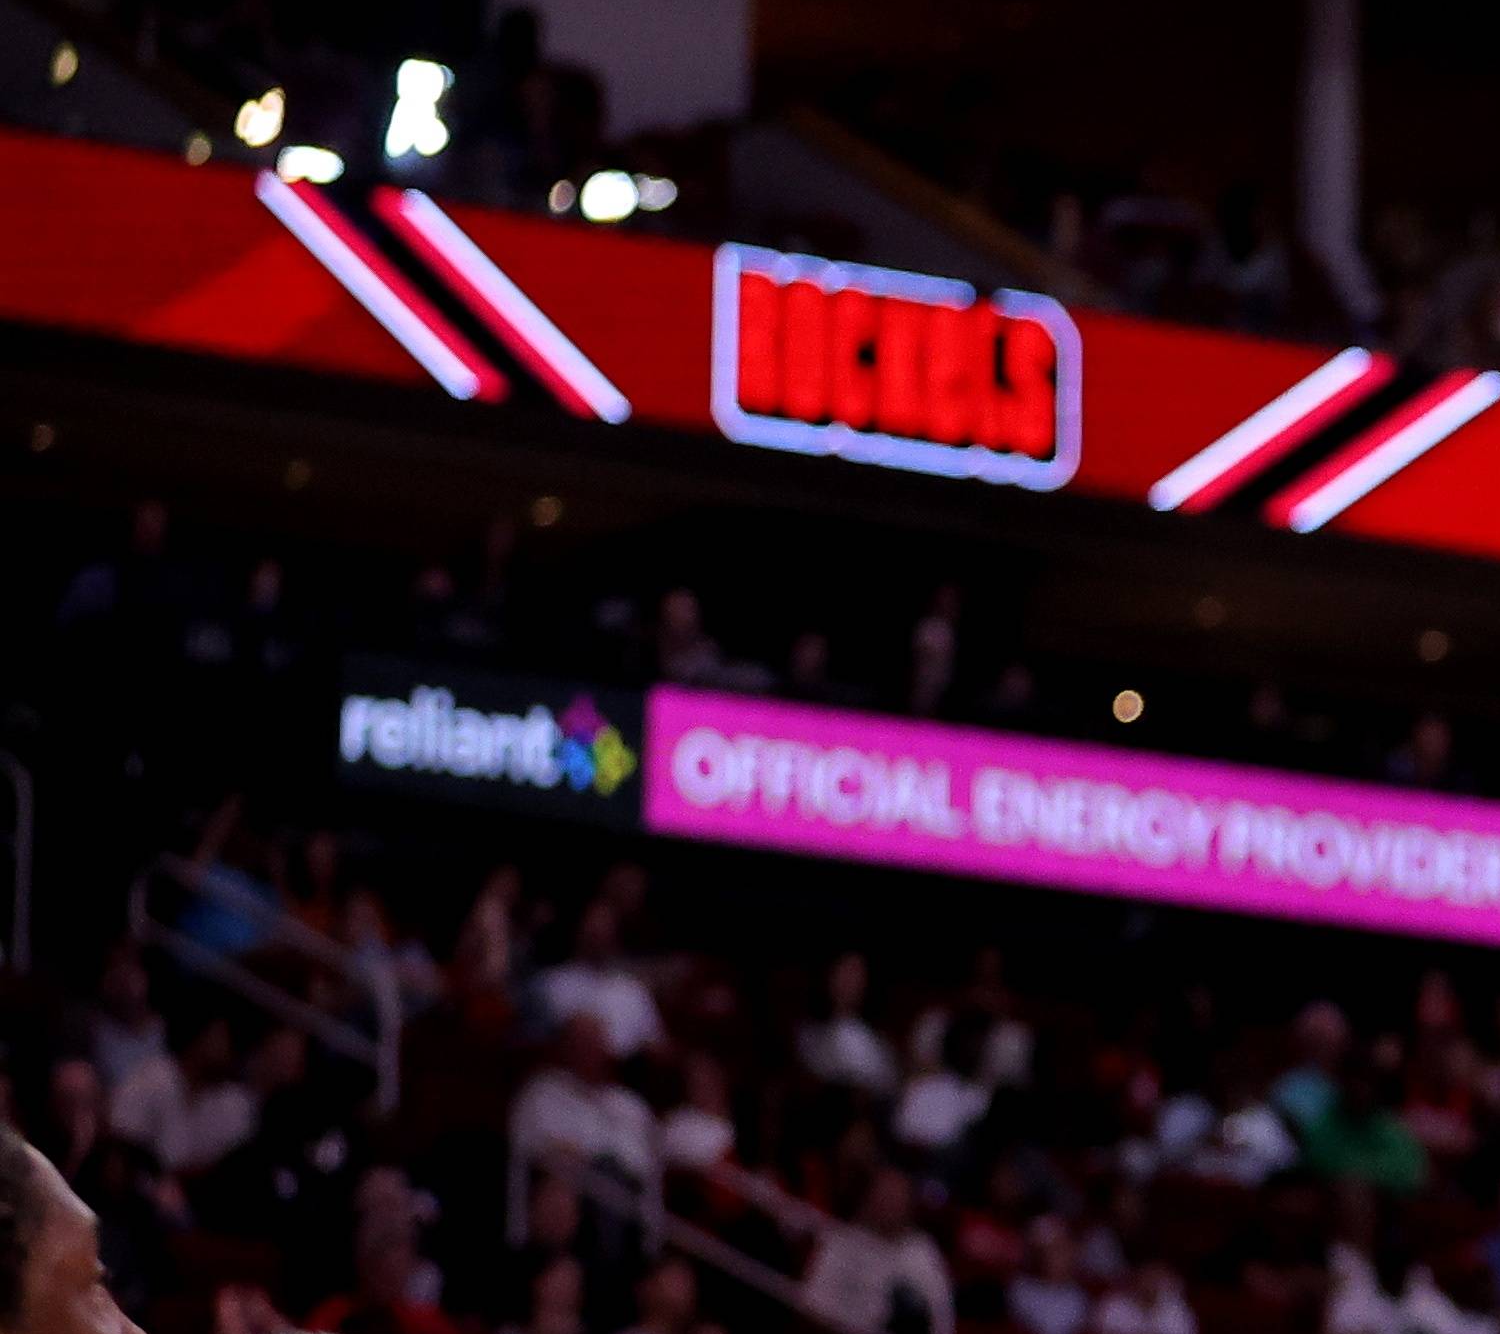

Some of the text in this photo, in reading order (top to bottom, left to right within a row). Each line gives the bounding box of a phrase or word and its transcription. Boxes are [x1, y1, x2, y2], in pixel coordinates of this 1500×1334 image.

[340, 685, 562, 789] reliant
[670, 727, 966, 839] OFFICIAL
[972, 766, 1216, 873] ENERGY
